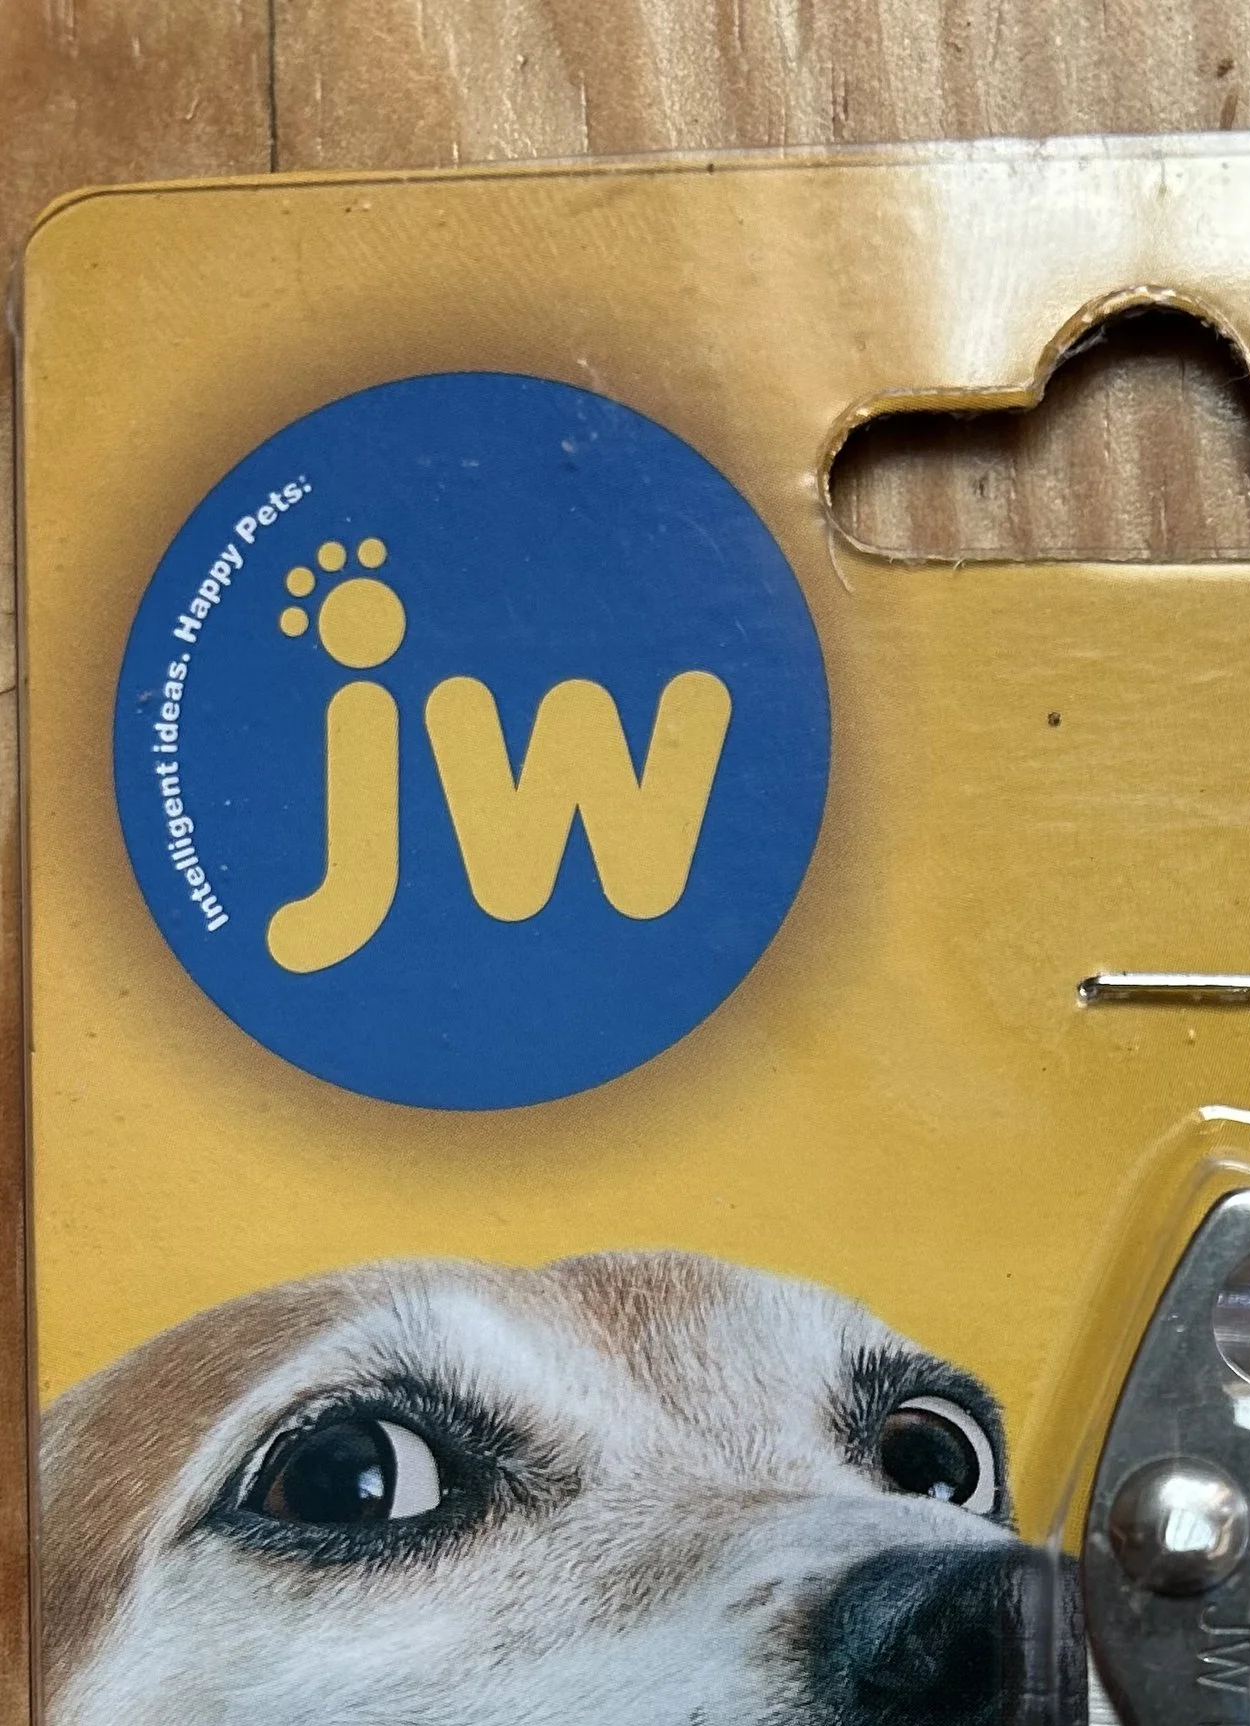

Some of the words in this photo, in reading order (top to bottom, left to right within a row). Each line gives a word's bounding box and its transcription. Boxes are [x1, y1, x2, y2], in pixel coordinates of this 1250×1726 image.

[173, 543, 245, 643] Happy
[152, 653, 190, 754] ideas.
[154, 759, 229, 931] Intelligent
